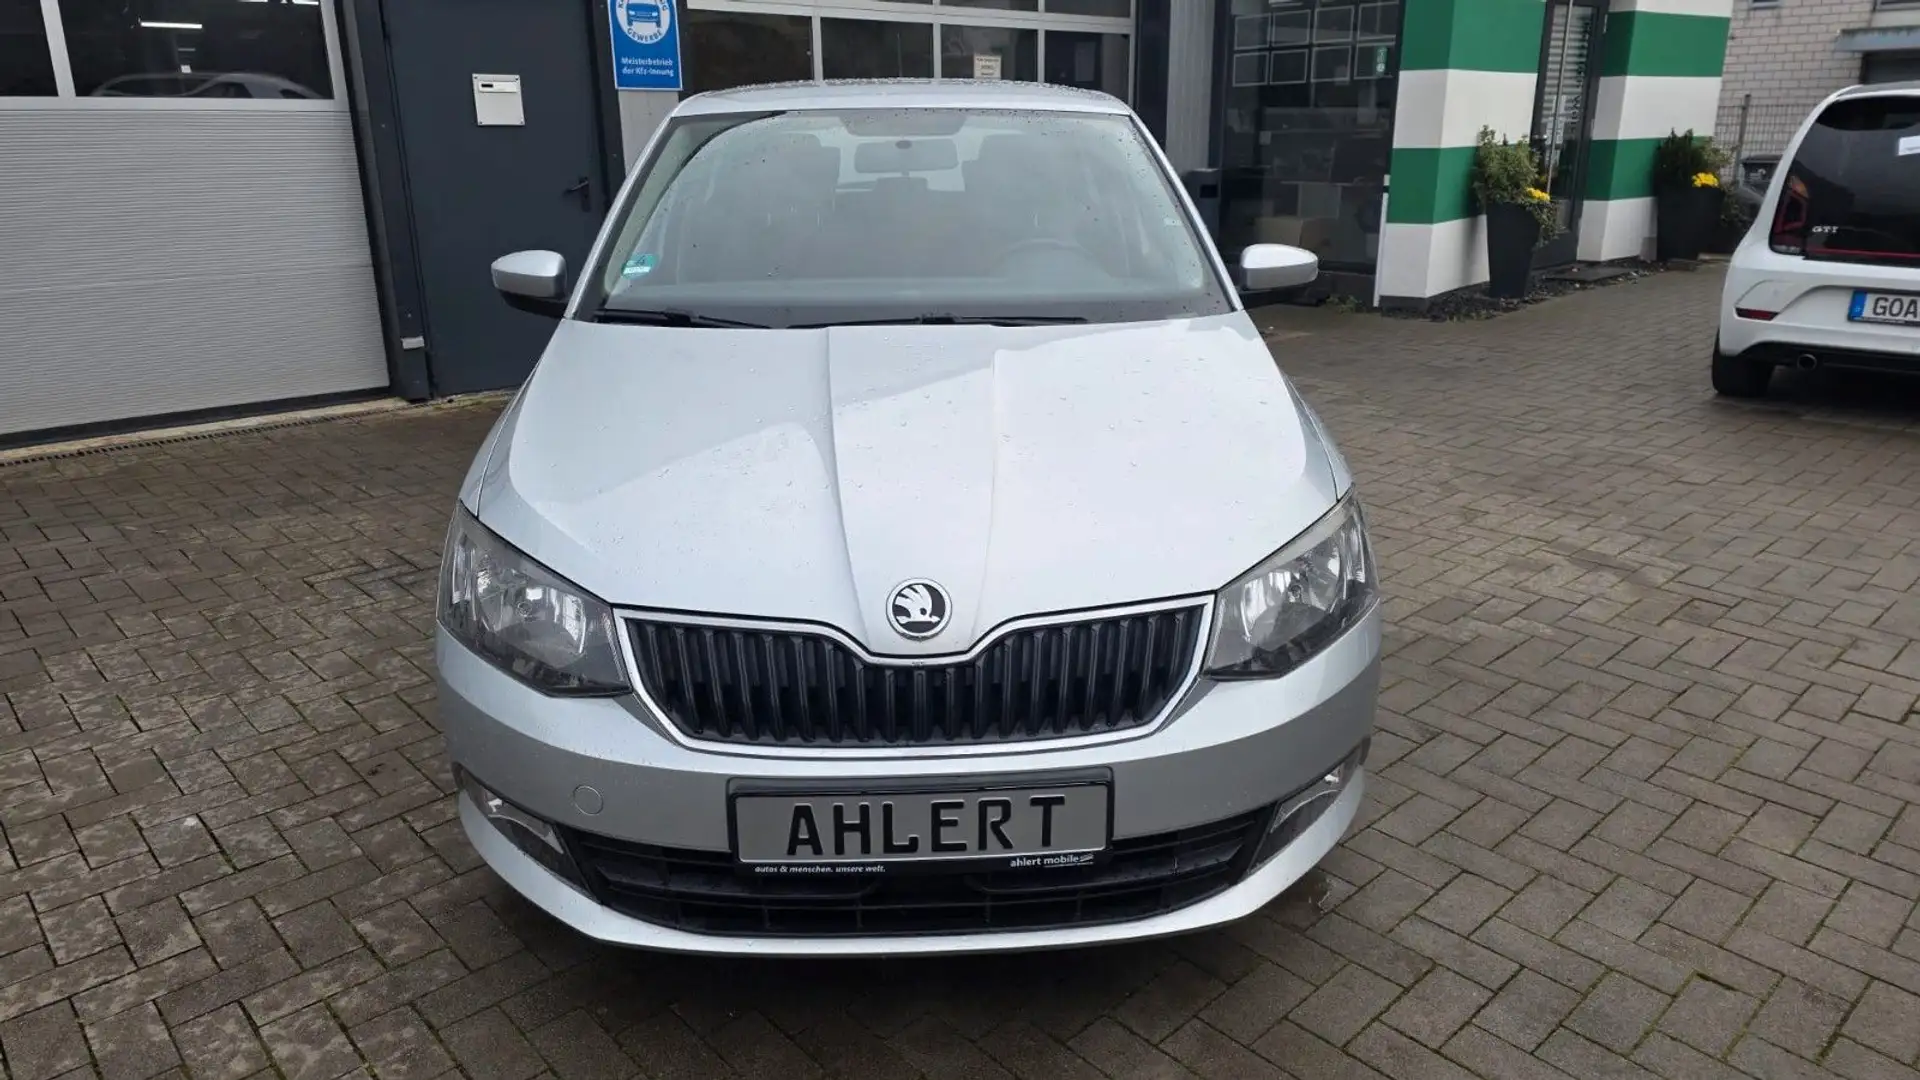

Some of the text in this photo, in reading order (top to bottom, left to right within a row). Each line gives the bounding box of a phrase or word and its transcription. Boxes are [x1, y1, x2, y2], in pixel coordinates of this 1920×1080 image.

[627, 27, 662, 42] GEWERBE
[621, 56, 673, 66] Meisterbetrieb
[622, 66, 674, 77] der Kfz-Innung
[1812, 225, 1839, 233] GTI
[1872, 296, 1918, 318] GOA
[786, 795, 1066, 856] AHLERT
[1010, 854, 1080, 868] ahlert mobile
[754, 865, 778, 873] autos
[789, 865, 833, 874] menschen.
[835, 865, 863, 873] unsere
[865, 865, 886, 873] welt.
